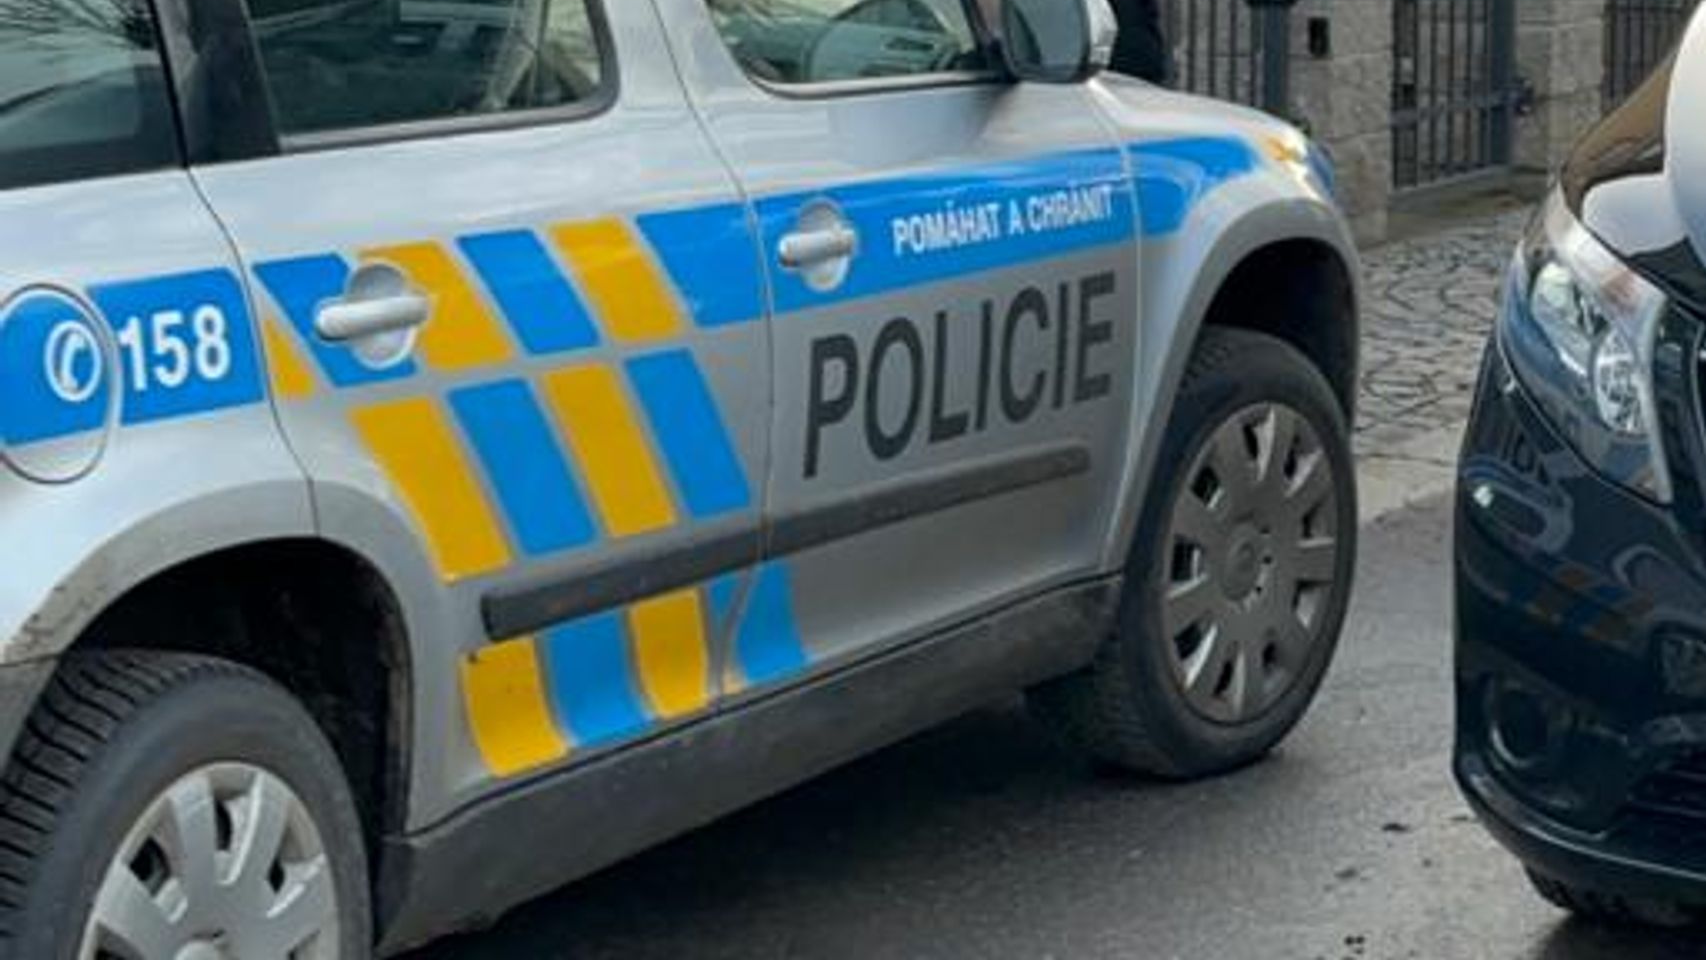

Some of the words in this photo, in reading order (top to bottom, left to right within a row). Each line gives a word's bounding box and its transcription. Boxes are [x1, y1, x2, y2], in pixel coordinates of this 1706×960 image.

[892, 200, 999, 256] POMÁHAT
[1009, 198, 1025, 236] A
[1027, 181, 1113, 233] CHRÁNIT
[117, 304, 231, 391] 158
[803, 271, 1116, 480] POLICIE
